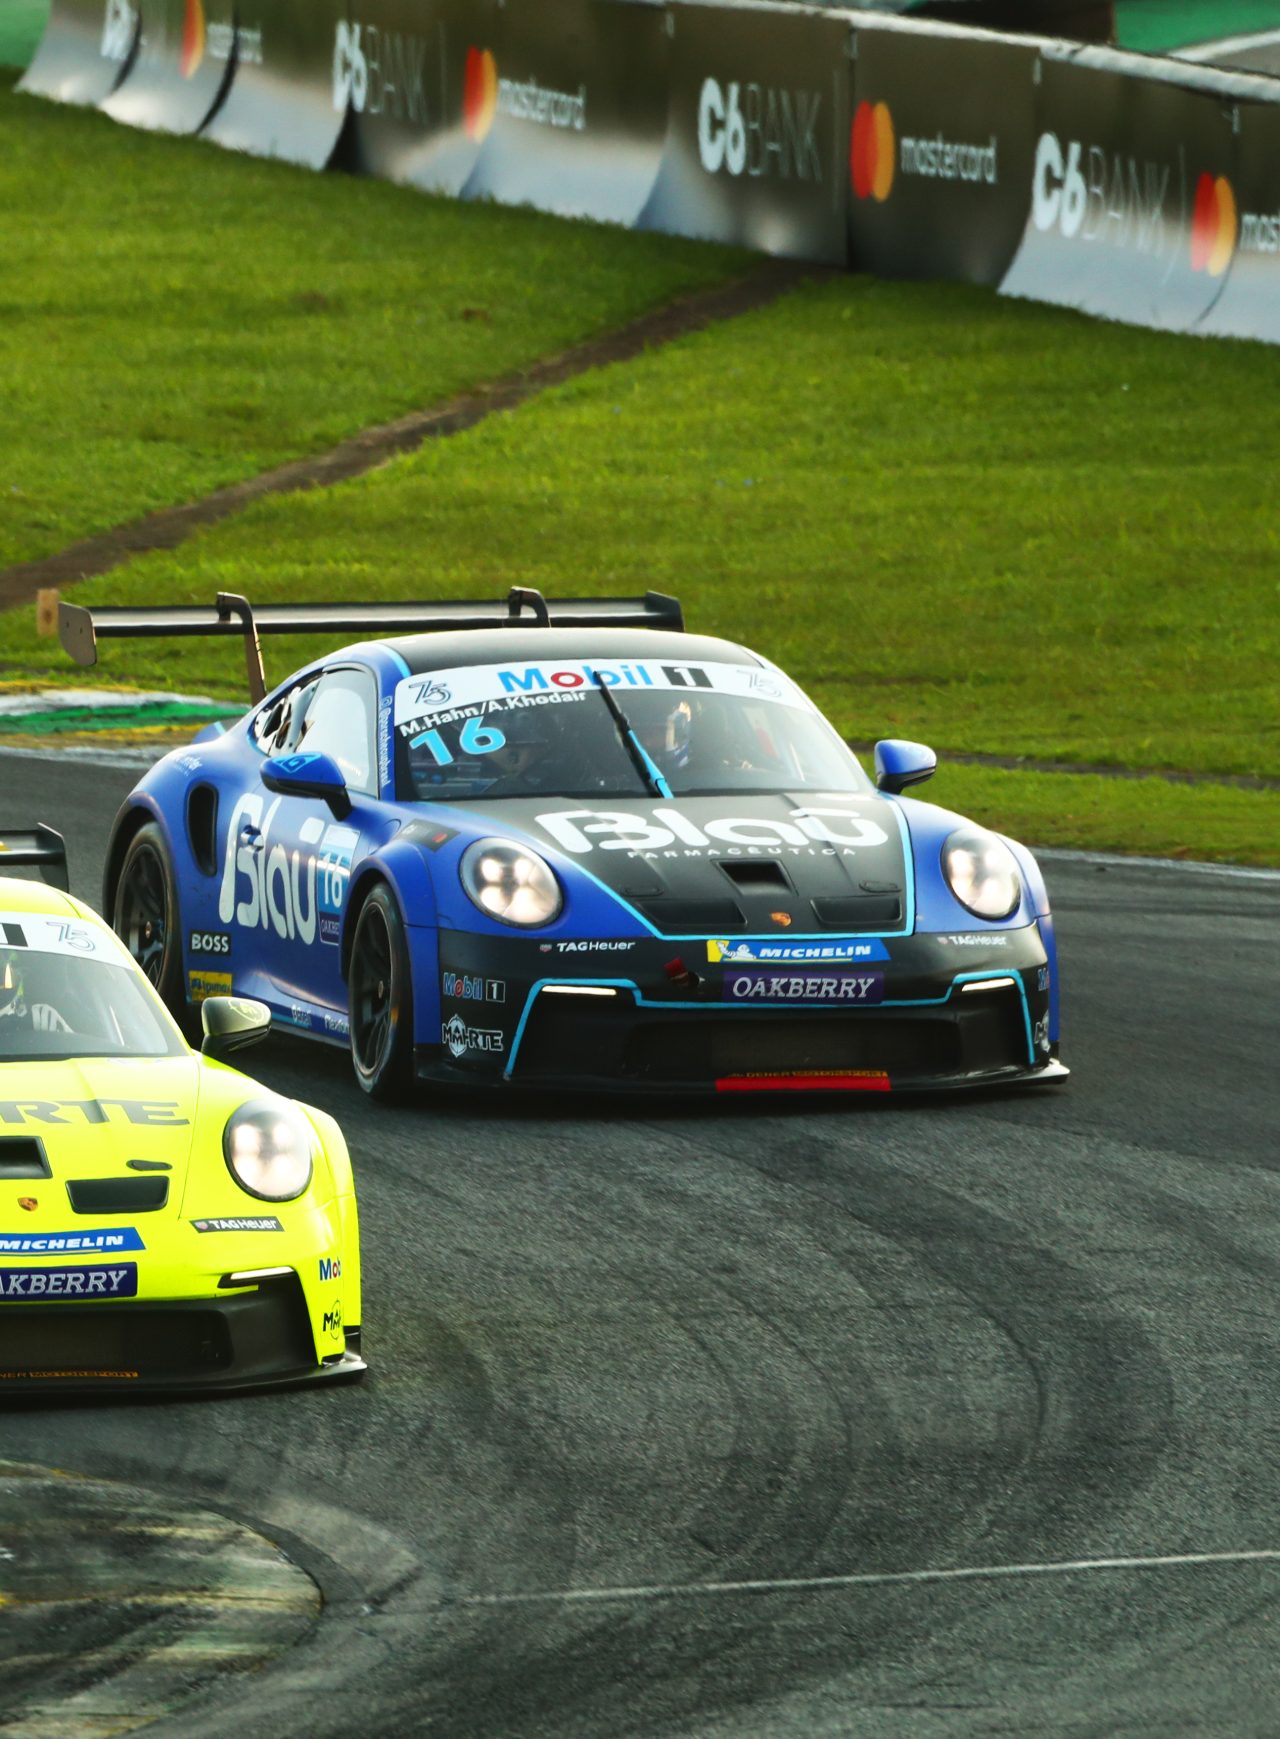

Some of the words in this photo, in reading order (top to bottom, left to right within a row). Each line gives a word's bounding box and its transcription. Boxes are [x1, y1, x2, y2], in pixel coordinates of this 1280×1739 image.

[901, 132, 997, 184] mastercard
[497, 664, 654, 693] Mobil
[672, 668, 697, 687] 1
[409, 715, 506, 766] 16
[320, 852, 344, 908] 16
[191, 933, 230, 953] BOSS
[759, 945, 871, 958] MICHELIN
[443, 972, 482, 1000] Mobil
